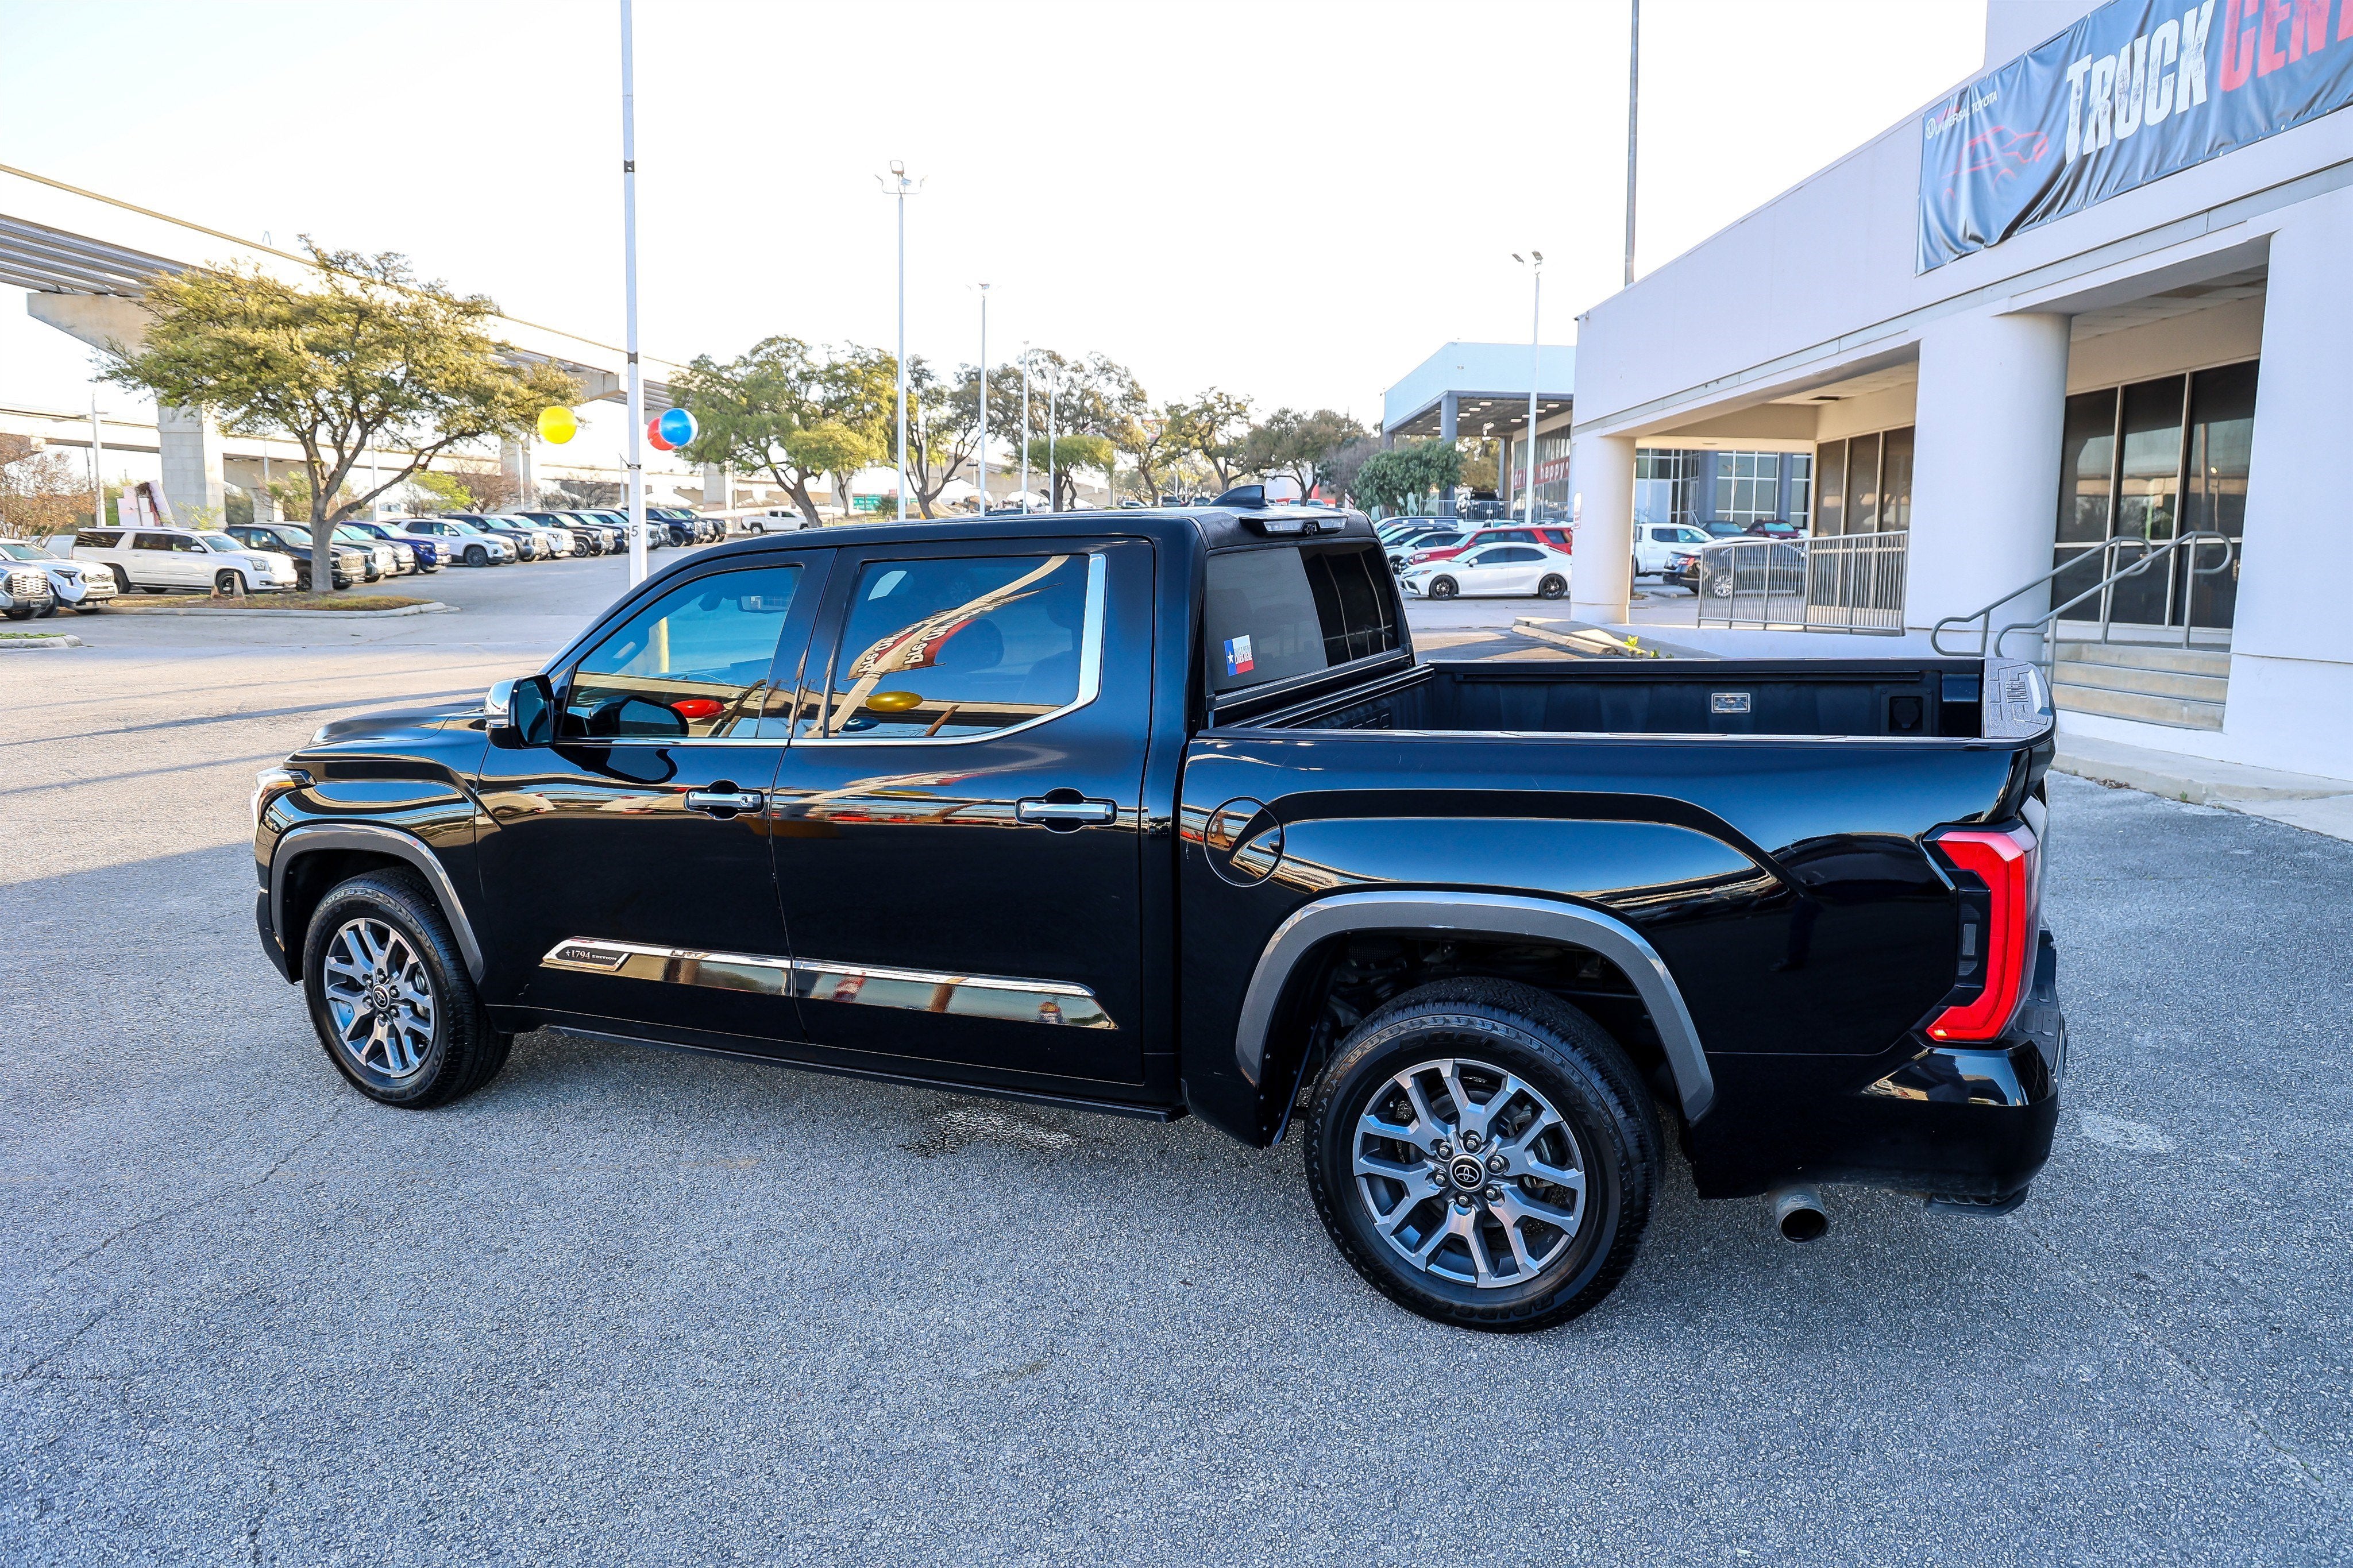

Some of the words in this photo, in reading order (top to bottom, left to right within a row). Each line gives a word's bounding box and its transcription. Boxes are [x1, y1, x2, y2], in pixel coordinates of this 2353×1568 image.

[2066, 0, 2216, 165] TRUCK
[2220, 0, 2353, 92] CEN
[1935, 108, 1970, 136] UNIVERSAL
[1972, 90, 1997, 114] TOYOTA
[1540, 459, 1565, 481] happy
[631, 525, 638, 537] 5
[572, 949, 591, 960] 1794
[1398, 1030, 1560, 1084] DUELER
[1352, 1240, 1556, 1318] BRIDGESTONE
